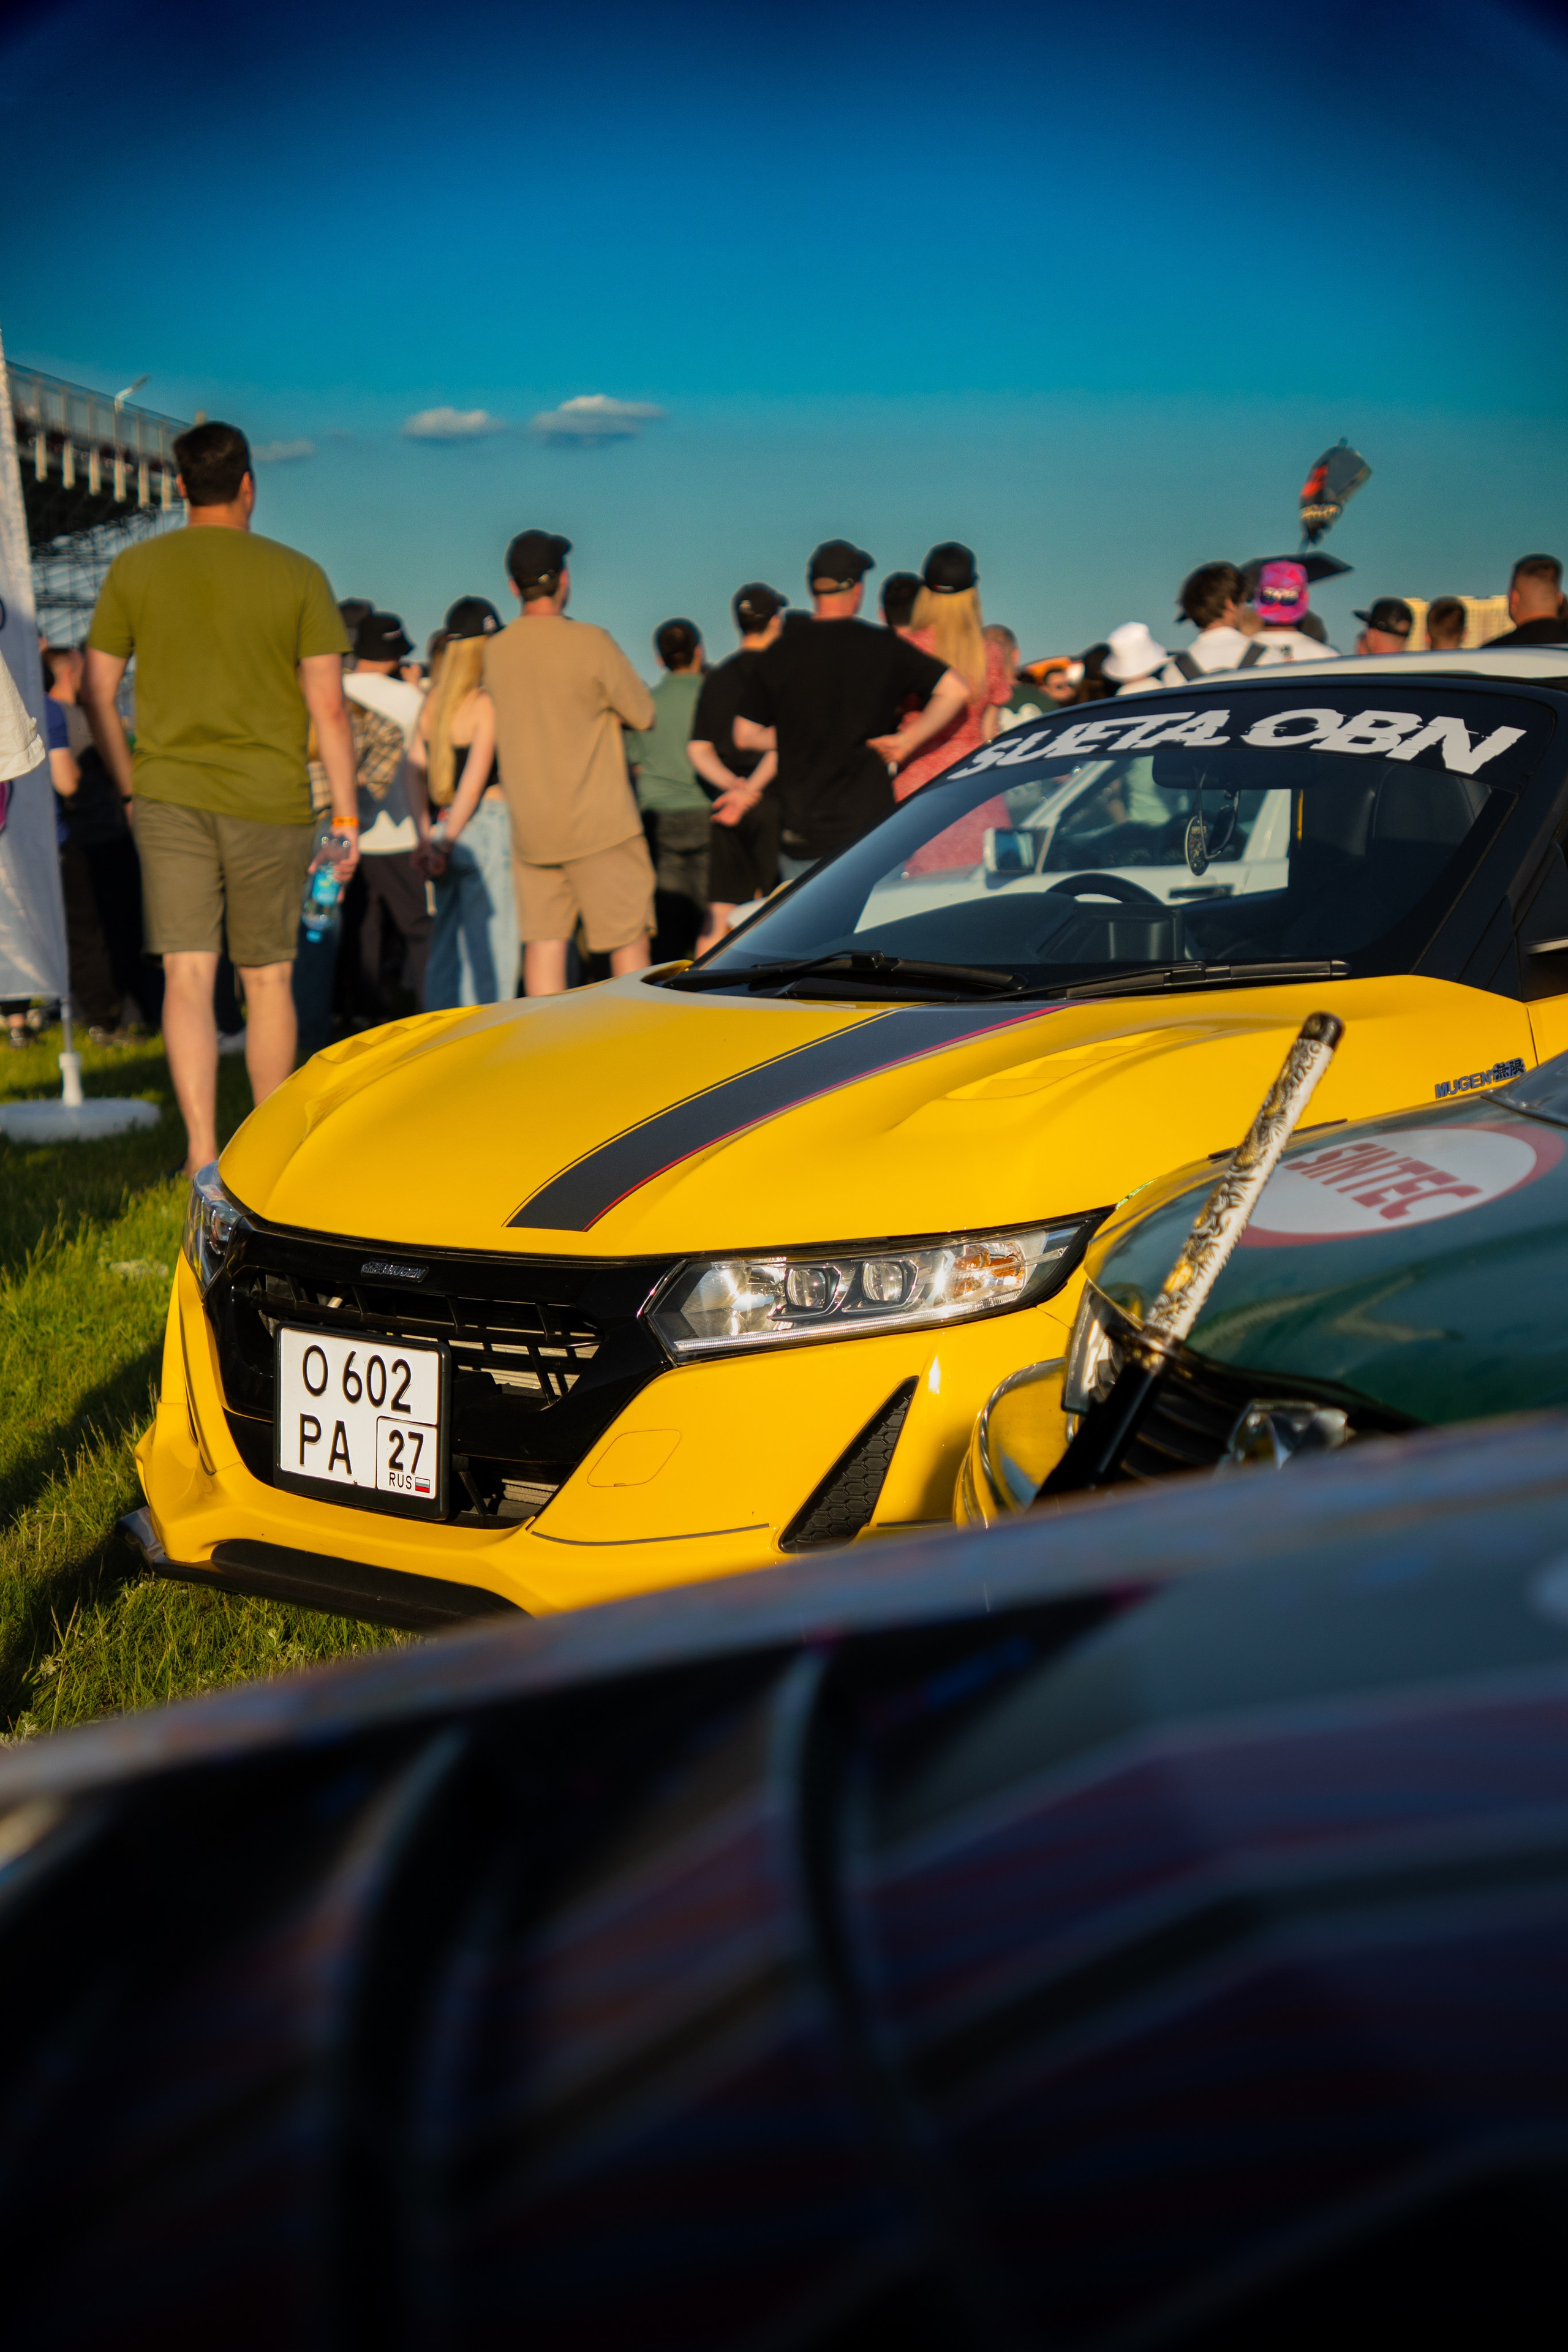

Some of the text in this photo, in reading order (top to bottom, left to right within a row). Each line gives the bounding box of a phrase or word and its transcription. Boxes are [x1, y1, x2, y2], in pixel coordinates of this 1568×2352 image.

[1240, 708, 1527, 775] OBN
[1435, 1070, 1493, 1098] MUGEN
[1283, 1142, 1483, 1220] SINTEC
[342, 1351, 412, 1414] 602
[388, 1429, 424, 1474] 27
[389, 1472, 412, 1490] RUS
